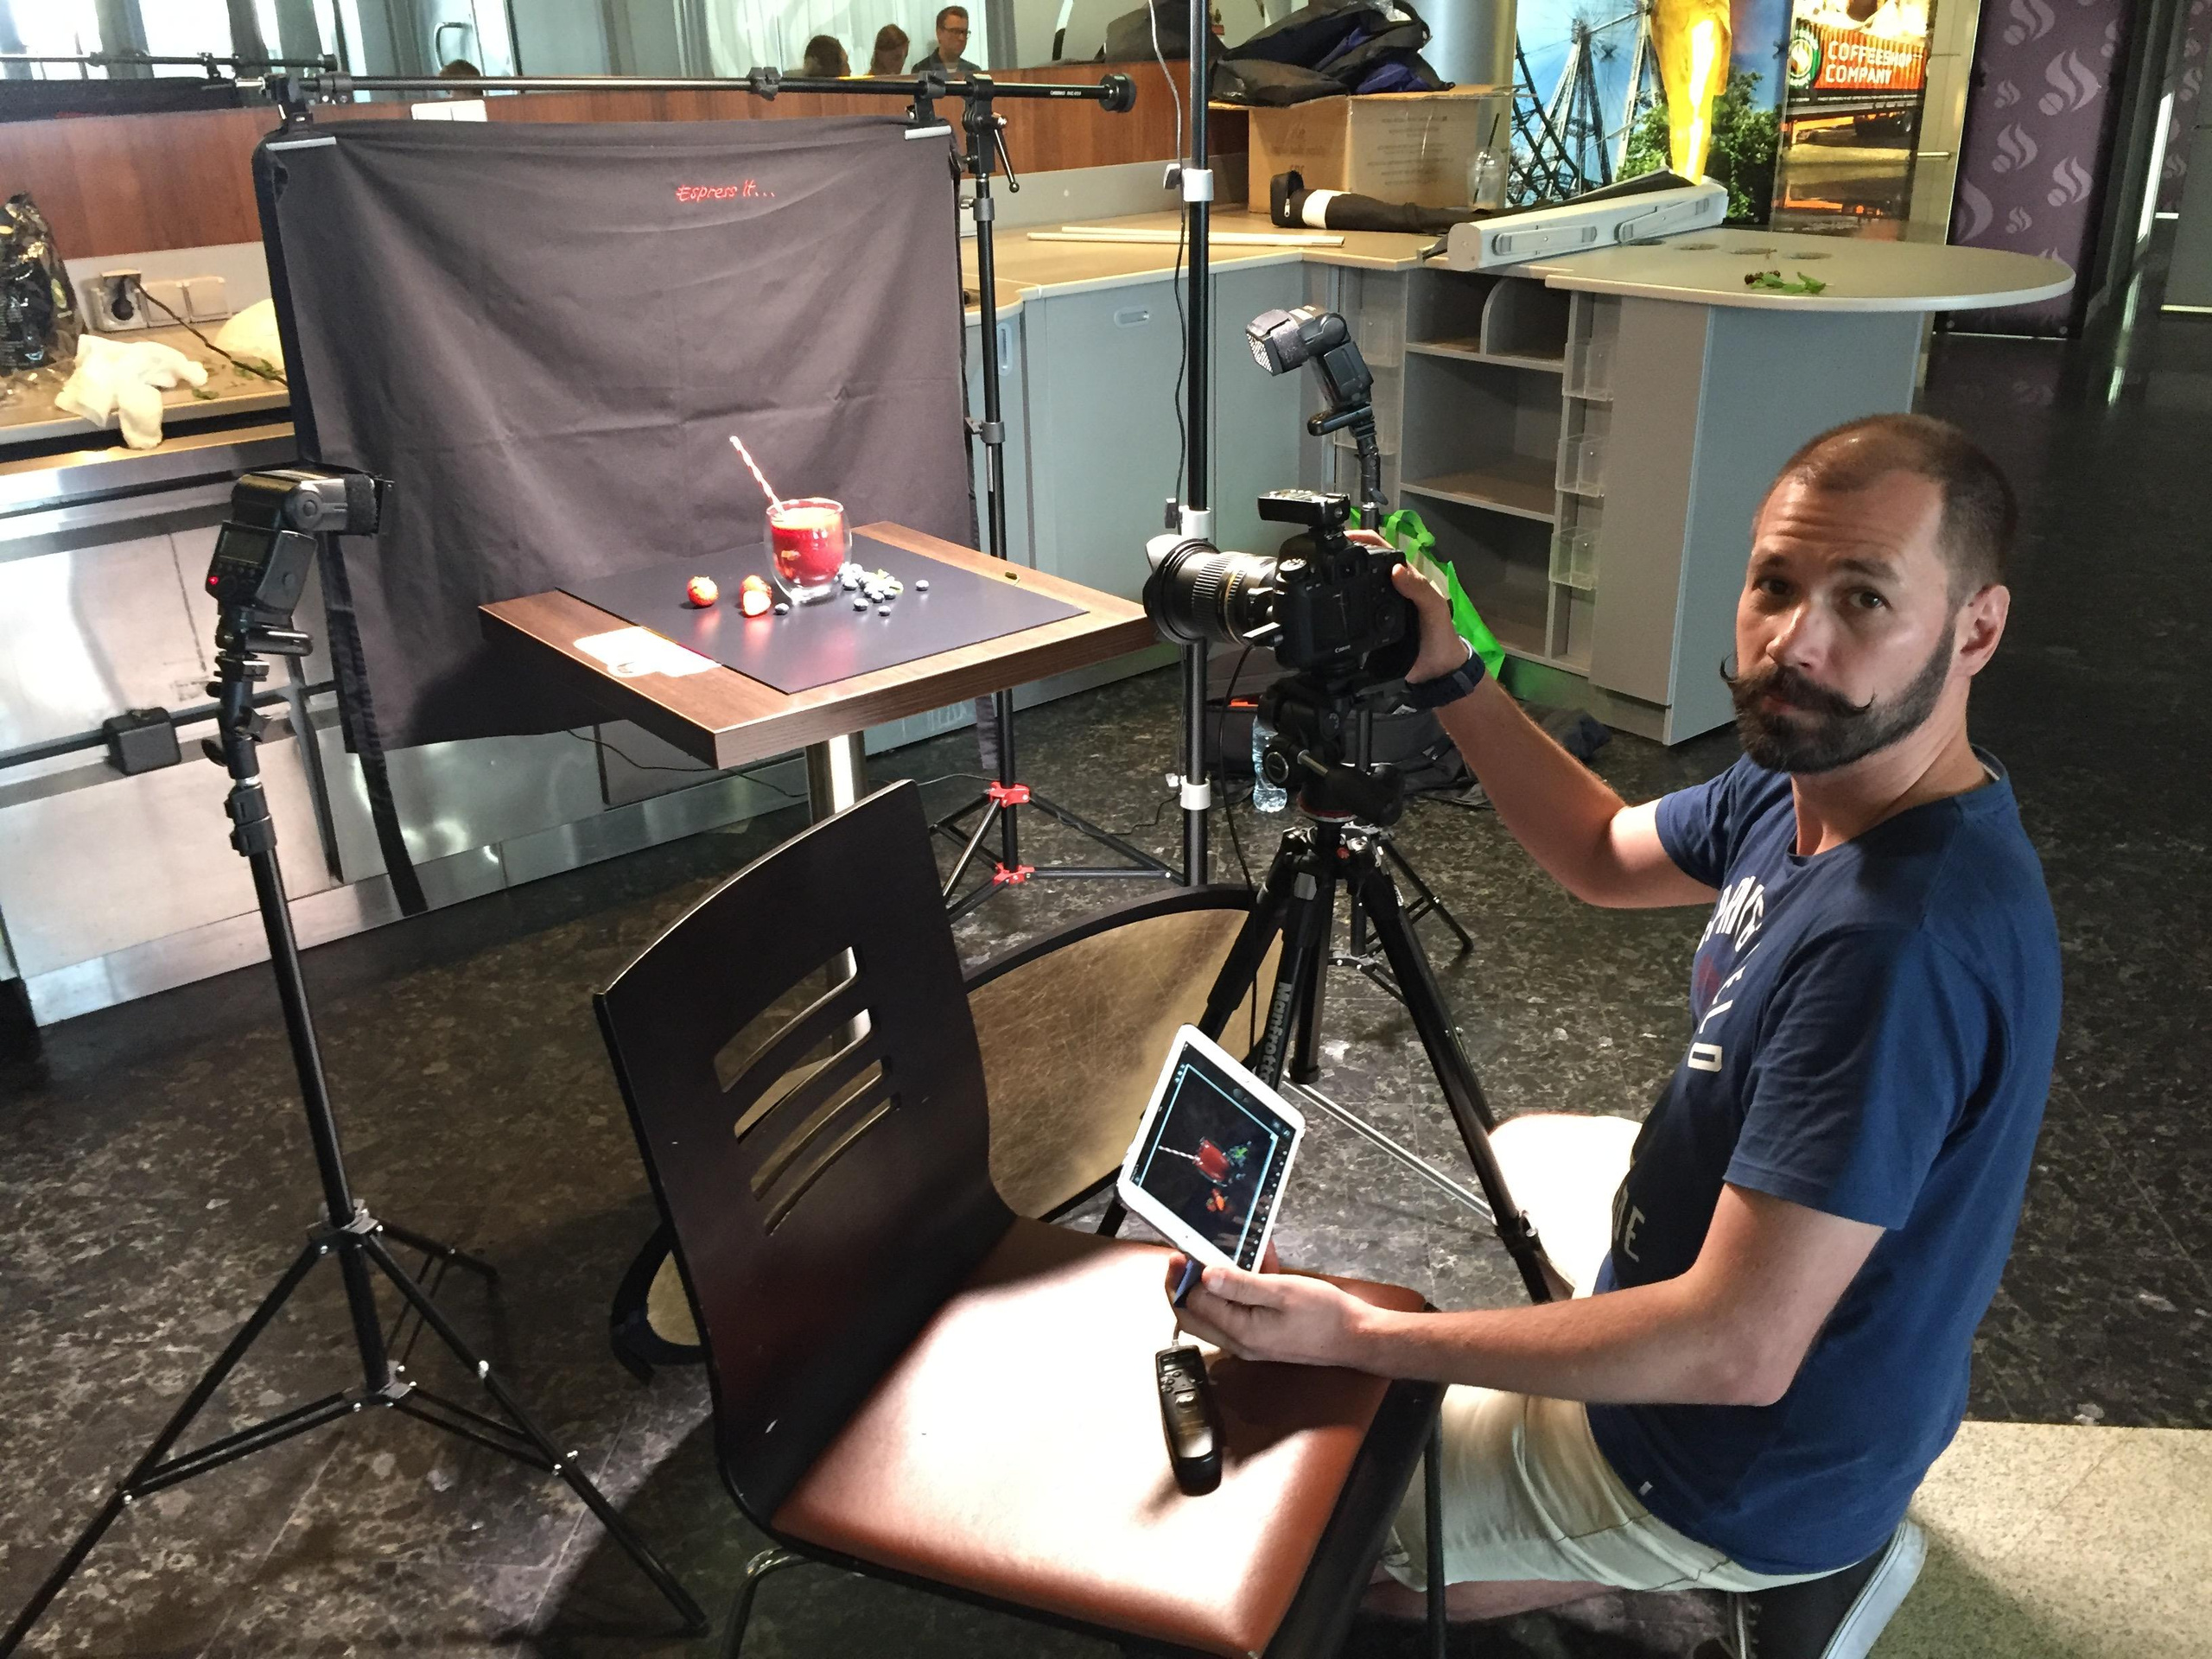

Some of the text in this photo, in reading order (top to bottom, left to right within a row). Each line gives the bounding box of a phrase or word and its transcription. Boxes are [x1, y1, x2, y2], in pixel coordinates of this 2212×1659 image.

[1827, 40, 1912, 68] COFFEESHOP
[1825, 63, 1892, 85] COMPANY
[676, 184, 738, 203] Espress
[1261, 982, 1292, 1084] Manfrotto
